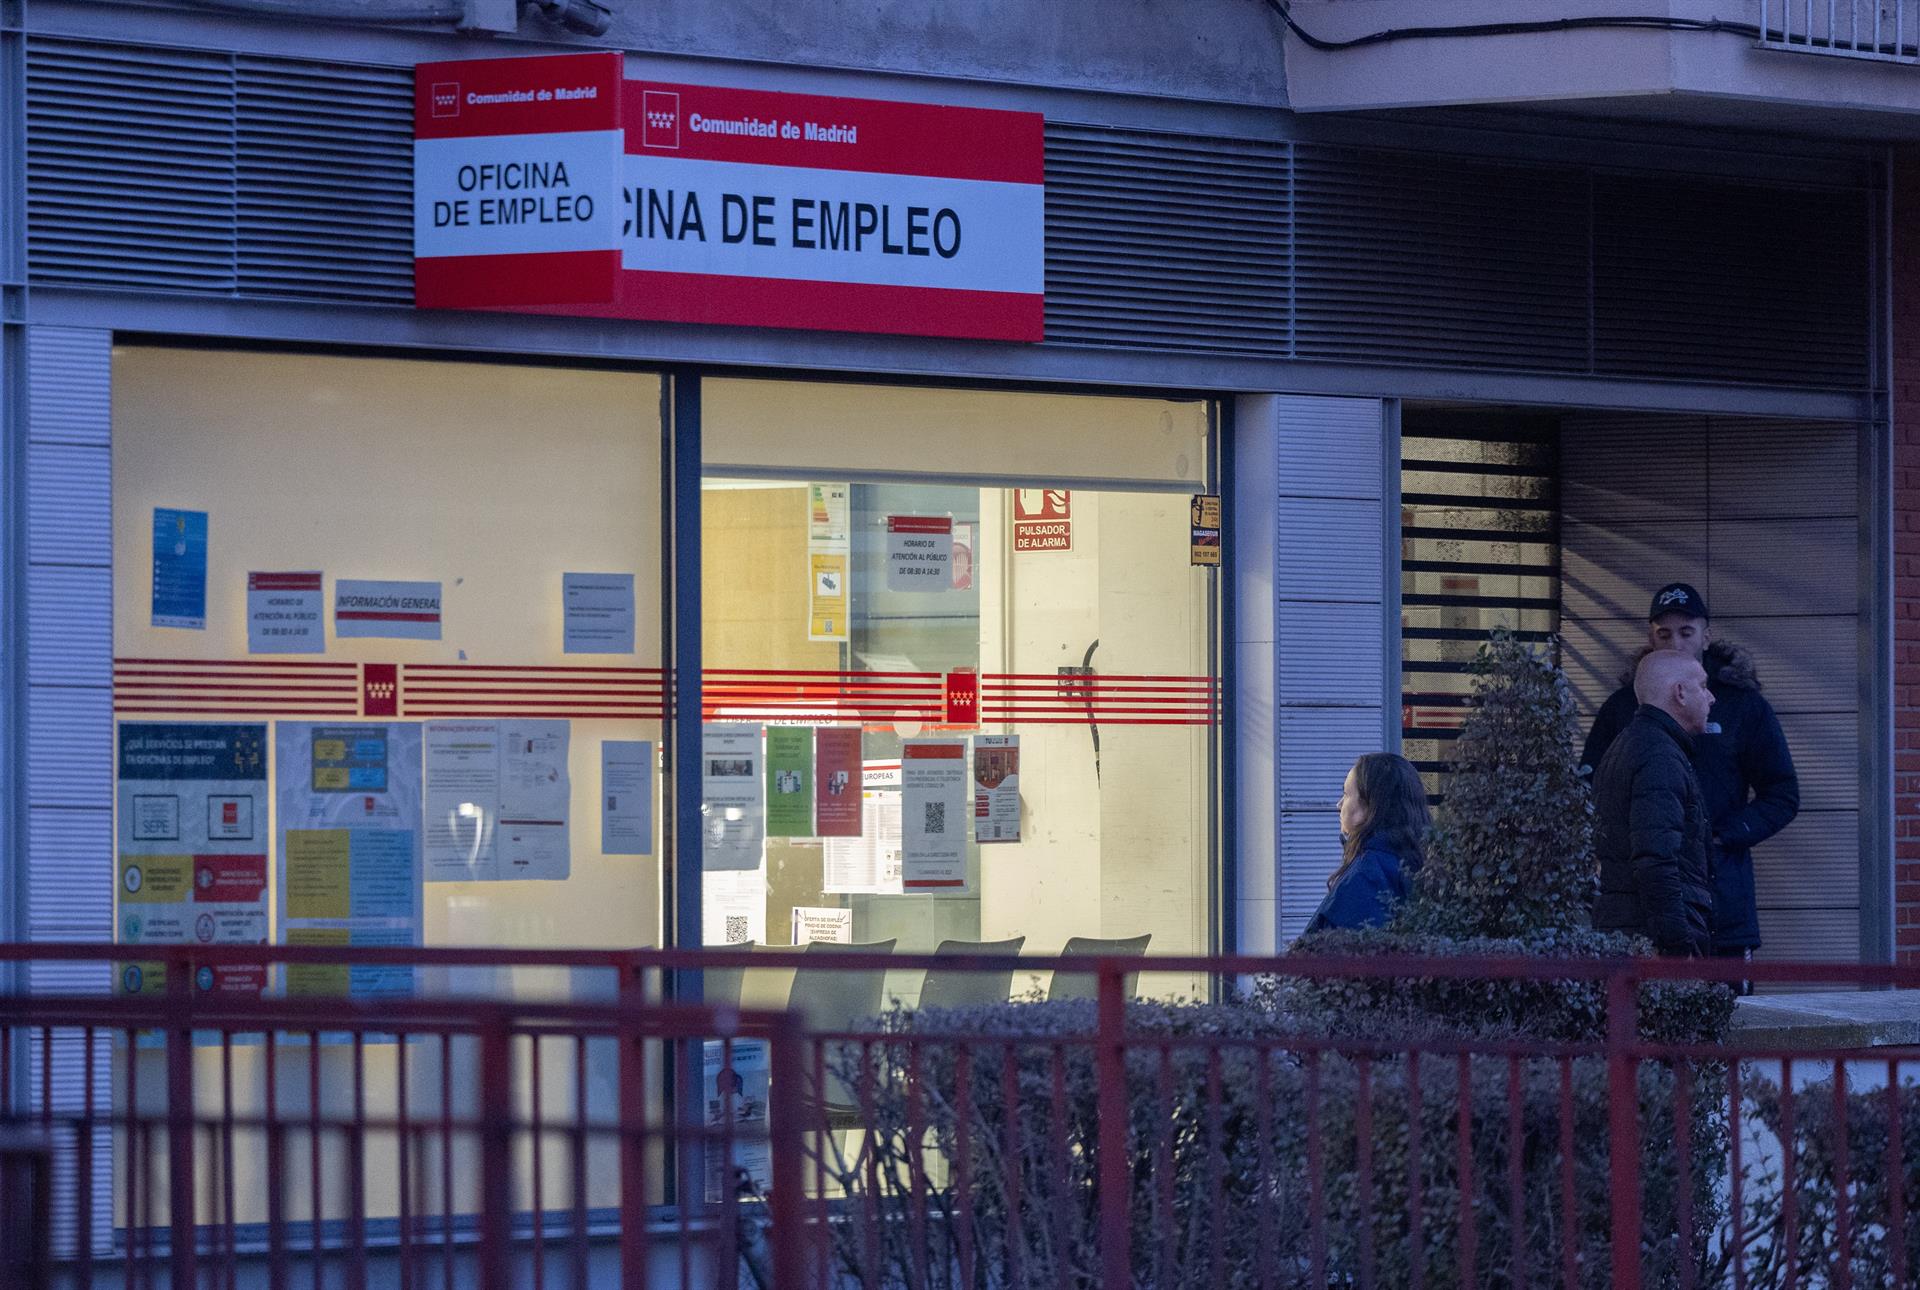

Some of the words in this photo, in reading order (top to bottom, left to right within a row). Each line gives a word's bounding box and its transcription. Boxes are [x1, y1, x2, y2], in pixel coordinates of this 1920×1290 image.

[467, 90, 534, 104] Comunidad
[537, 89, 552, 100] de
[555, 86, 597, 100] Madrid
[689, 113, 777, 138] Comunidad
[781, 120, 800, 139] de
[804, 122, 857, 144] Madrid
[458, 161, 570, 192] OFICINA
[434, 201, 469, 227] DE
[480, 195, 593, 225] EMPLEO
[722, 193, 776, 247] DE
[792, 198, 961, 259] EMPLEO
[1019, 525, 1066, 536] PULSADOR
[903, 540, 927, 548] HORARIO
[928, 540, 935, 548] DE
[1018, 538, 1030, 548] DE
[1031, 537, 1068, 548] ALARMA
[891, 552, 917, 561] ATENCIÓN
[926, 552, 947, 562] PÚBLICO
[899, 567, 906, 575] DE
[922, 567, 927, 575] A
[338, 595, 399, 609] INFORMACIÓN
[401, 598, 440, 610] GENERAL
